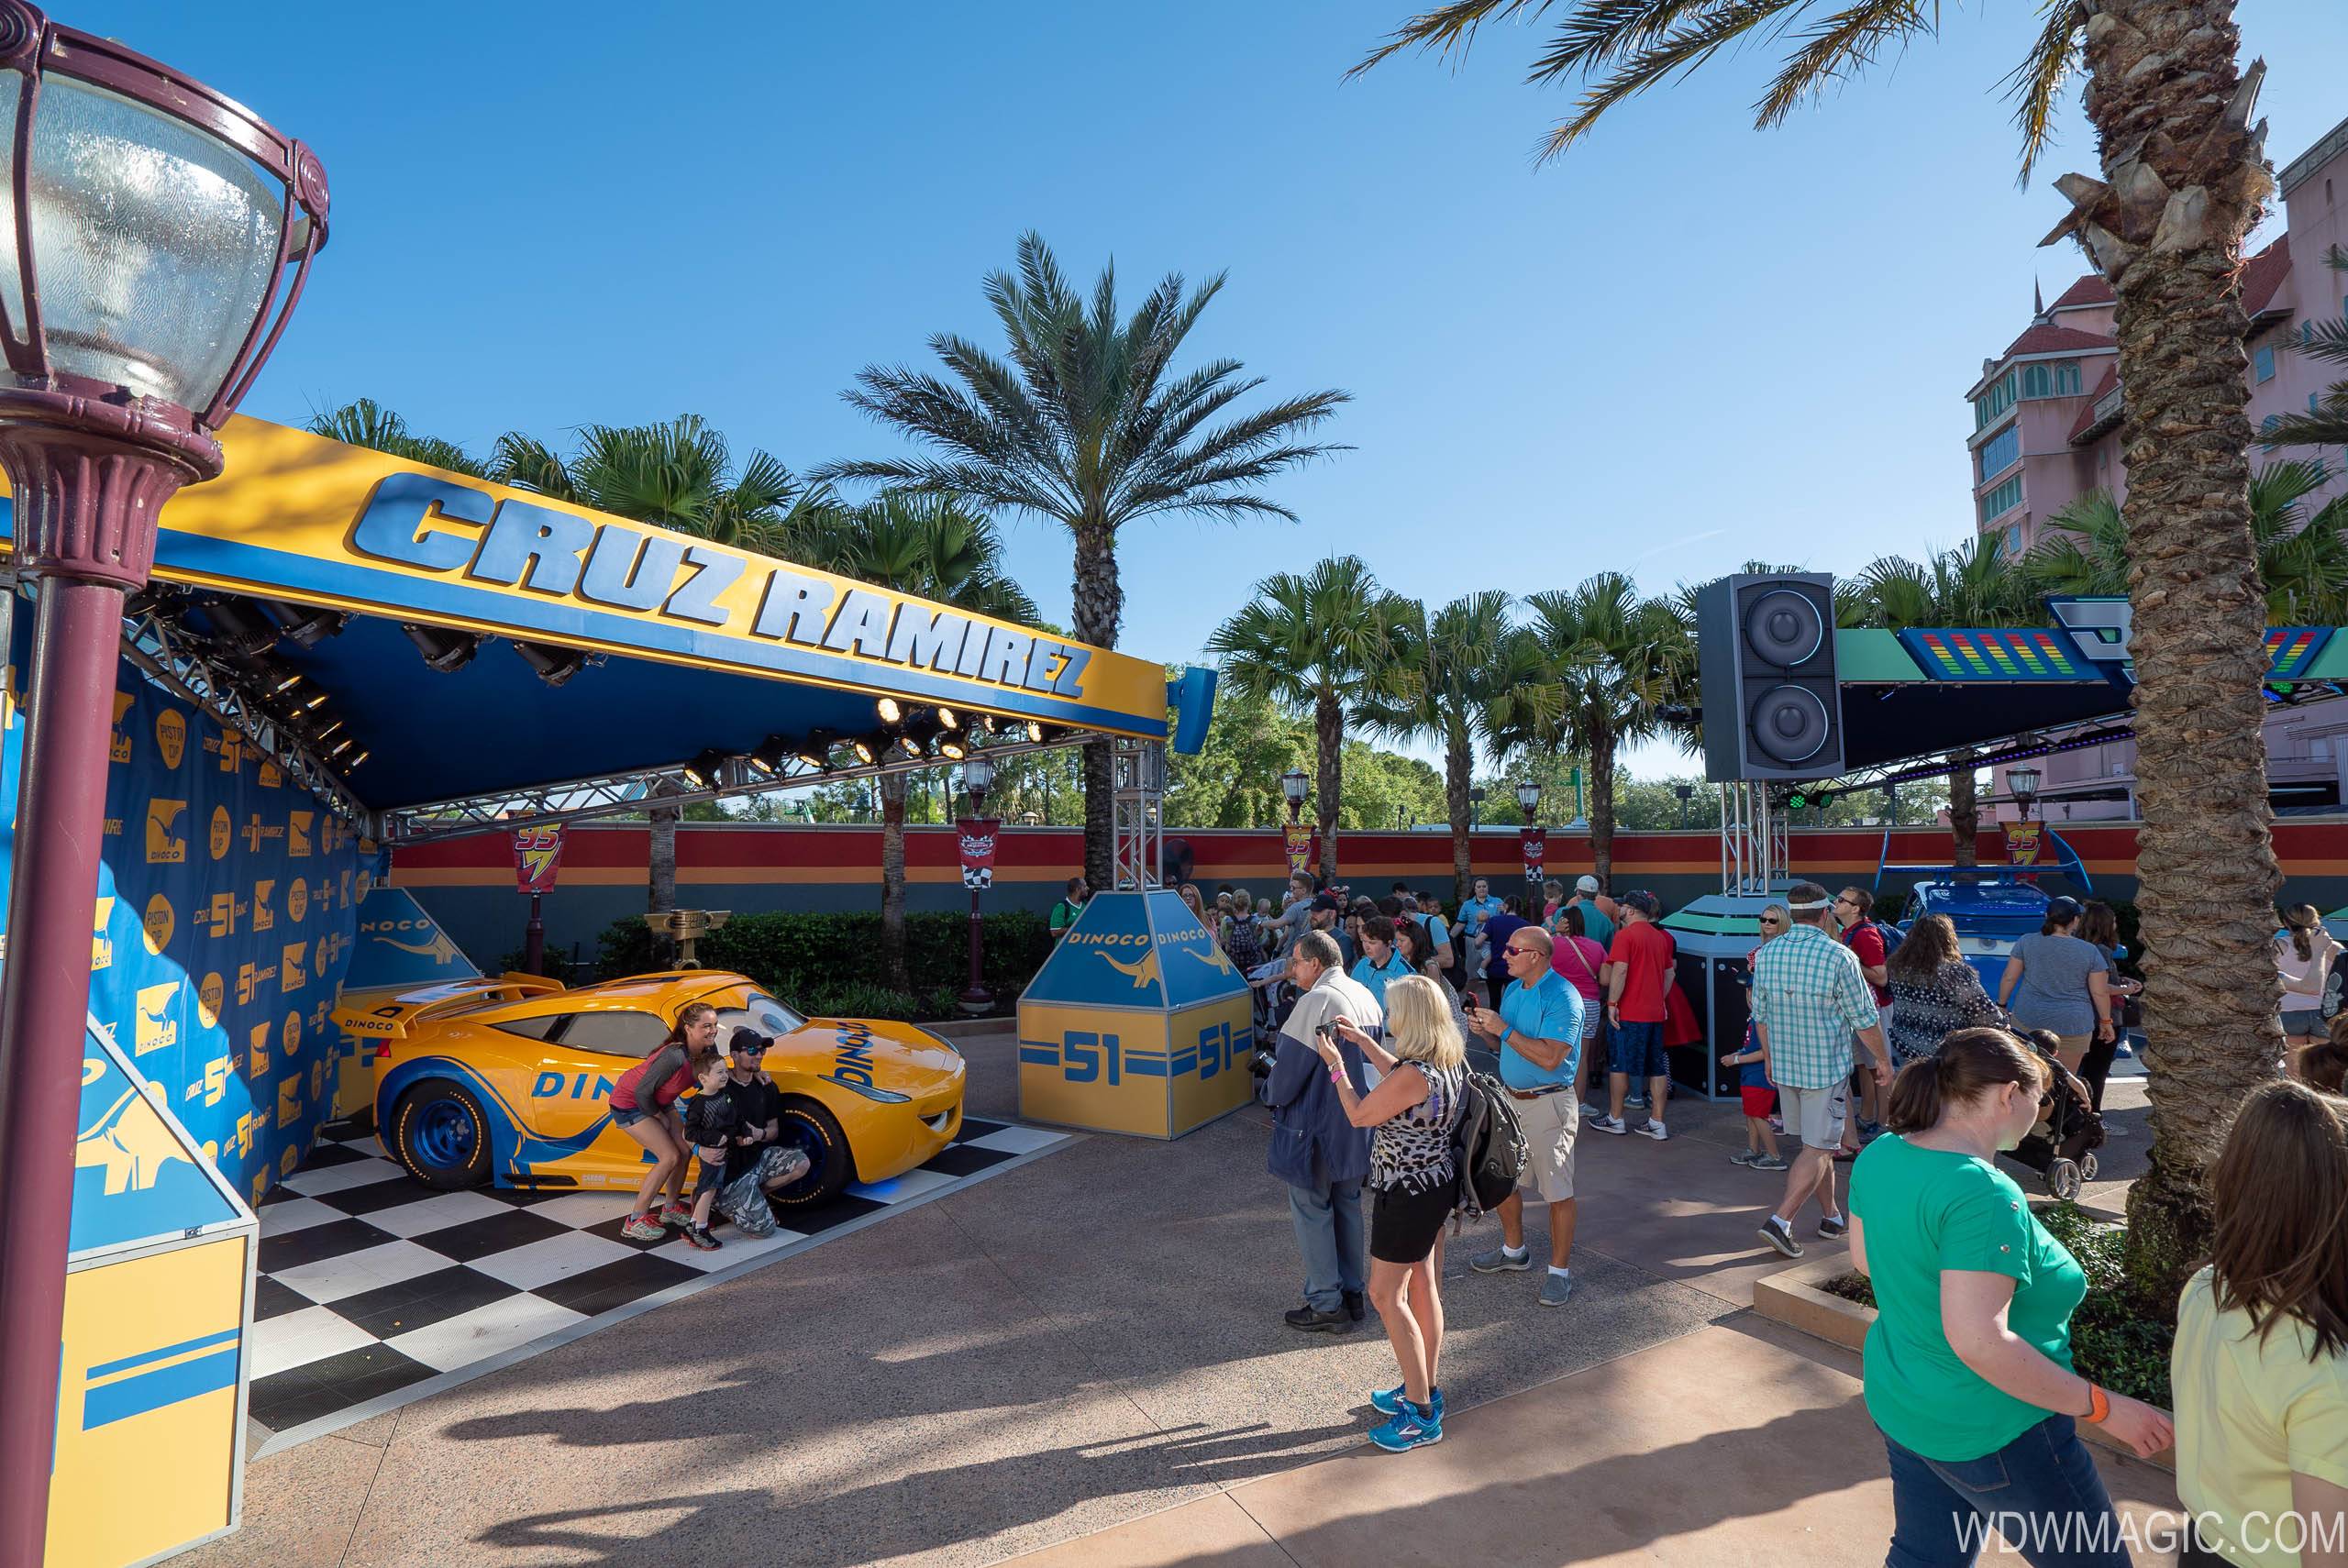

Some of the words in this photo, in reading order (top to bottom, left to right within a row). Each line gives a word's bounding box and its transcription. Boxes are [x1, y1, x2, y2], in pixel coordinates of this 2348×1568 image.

[351, 471, 748, 625] CRUZ
[752, 569, 1093, 699] RAMIREZ
[515, 823, 561, 851] 95
[1286, 833, 1312, 855] 95
[2006, 829, 2040, 851] 95
[147, 910, 169, 926] PISTON
[210, 892, 235, 938] 51
[360, 919, 428, 933] NOCO
[1068, 932, 1150, 947] DINOCO
[1158, 928, 1206, 945] DINOCO
[238, 962, 255, 1006] 51
[345, 1019, 394, 1031] DINOCO
[138, 1034, 173, 1052] DINOCO
[834, 1021, 874, 1088] DINOCO
[1198, 1021, 1232, 1081] 51
[1064, 1030, 1121, 1087] 51
[205, 1055, 228, 1108] 51
[532, 1071, 617, 1100] DIN
[237, 1110, 253, 1160] 51
